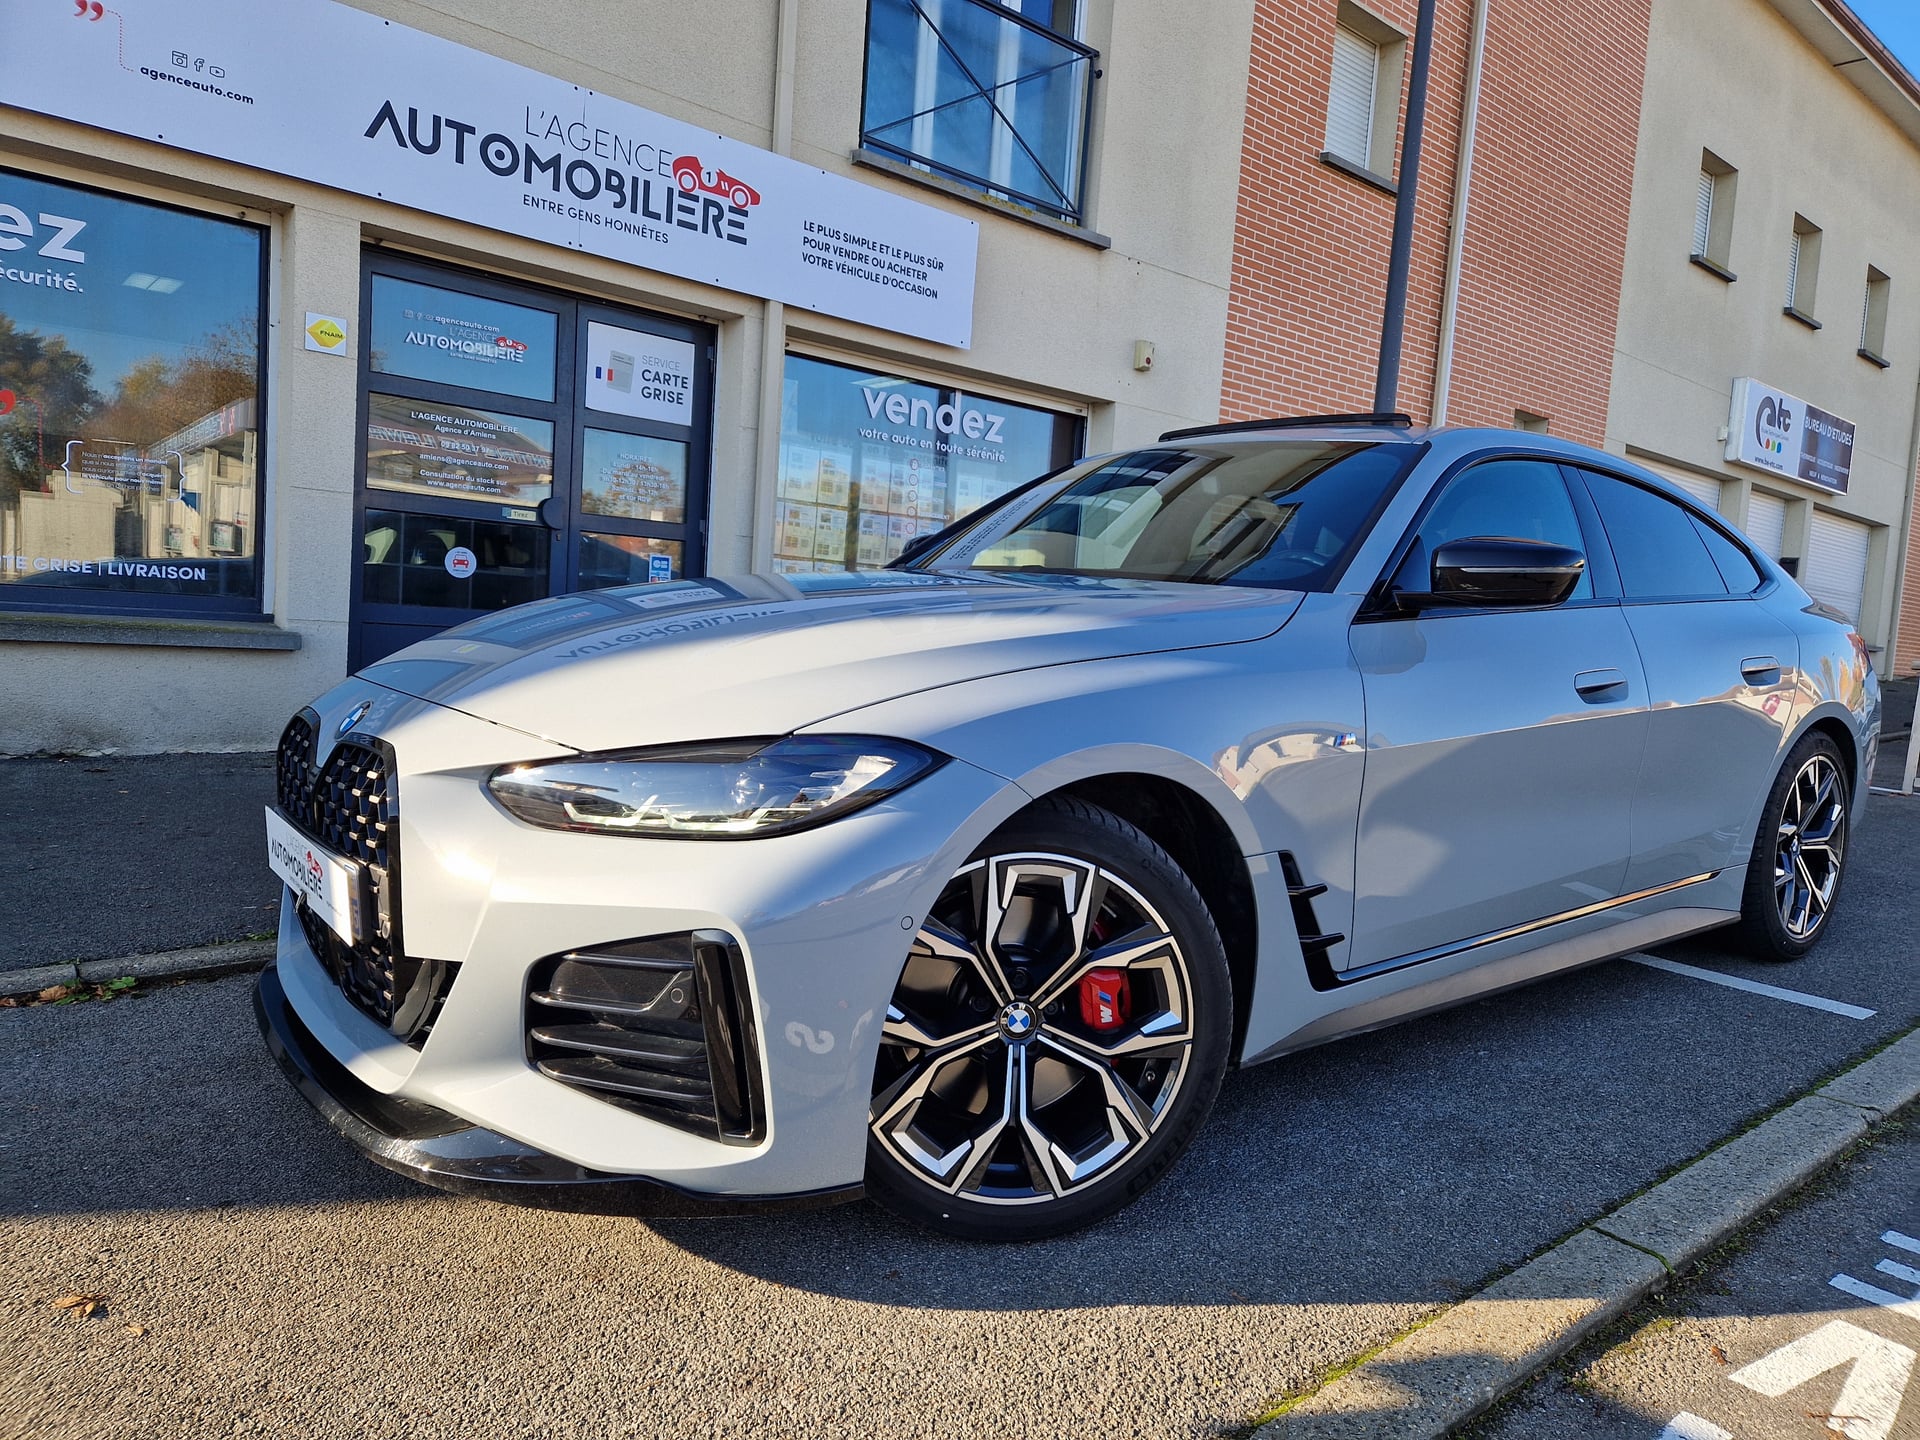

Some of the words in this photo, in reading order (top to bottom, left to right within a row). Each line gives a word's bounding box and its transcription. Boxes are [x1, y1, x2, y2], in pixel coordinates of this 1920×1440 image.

[140, 67, 254, 104] agenceauto.com
[526, 106, 673, 178] L'AGENCE
[523, 194, 564, 215] ENTRE
[567, 207, 601, 224] GENS
[605, 217, 669, 244] HONNÊTES
[803, 220, 815, 233] LE
[816, 224, 841, 241] PLUS
[843, 232, 877, 251] SIMPLE
[879, 244, 890, 254] ET
[891, 247, 902, 259] LE
[903, 251, 926, 266] PLUS
[927, 257, 944, 271] SÛR
[803, 236, 831, 253] POUR
[832, 245, 870, 264] VENDRE
[871, 257, 886, 269] OU
[887, 262, 928, 281] ACHETER
[802, 252, 833, 270] VOTRE
[835, 261, 881, 283] VÉHICULE
[882, 275, 938, 299] D'OCCASION
[320, 330, 343, 339] FNAIM
[435, 316, 500, 333] agenceauto.com
[449, 327, 498, 343] L'AGENCE
[641, 354, 681, 372] SERVICE
[641, 369, 689, 390] CARTE
[641, 386, 684, 405] GRISE
[411, 411, 452, 424] L'AGENCE
[863, 387, 1005, 443] vendez
[435, 424, 463, 435] Agence
[464, 428, 497, 440] d'Amiens
[1804, 416, 1827, 438] BUREAU
[860, 427, 889, 441] votre
[892, 434, 917, 446] auto
[920, 438, 933, 449] en
[935, 441, 964, 456] toute
[966, 445, 1008, 464] sérénité.
[419, 453, 509, 471] amiens@agenceauto.com
[420, 470, 464, 481] Consultation
[476, 476, 495, 485] stock
[427, 479, 501, 494] www.agenceauto.com
[33, 557, 93, 574] GRISE
[108, 561, 206, 580] LIVRAISON
